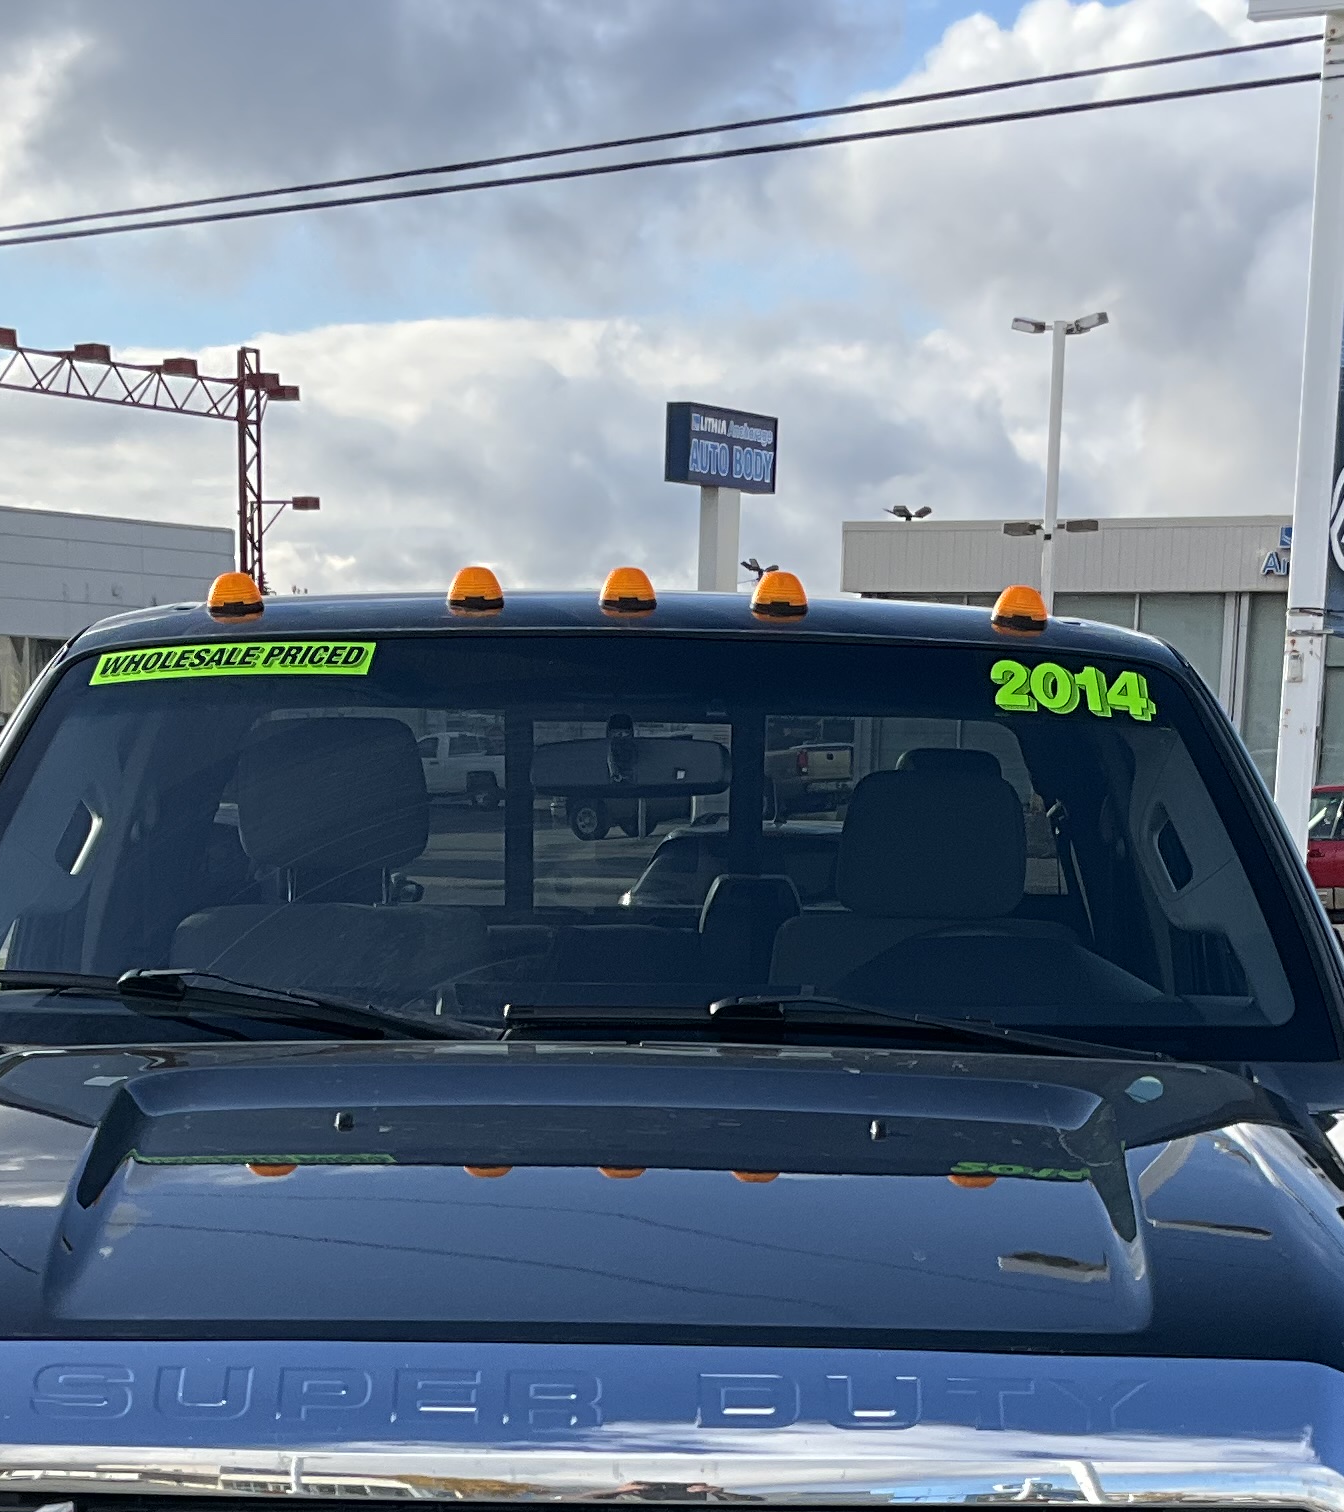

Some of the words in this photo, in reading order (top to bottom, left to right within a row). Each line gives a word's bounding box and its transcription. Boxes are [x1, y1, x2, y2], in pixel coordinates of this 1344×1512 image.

[700, 416, 727, 435] LITHIA
[689, 438, 729, 476] AUTO
[733, 446, 774, 483] BODY
[100, 646, 265, 678] WHOLESALE
[262, 644, 369, 668] PRICED
[990, 659, 1157, 722] 2014
[31, 1362, 603, 1427] SUPER
[696, 1372, 1155, 1434] DUTY
